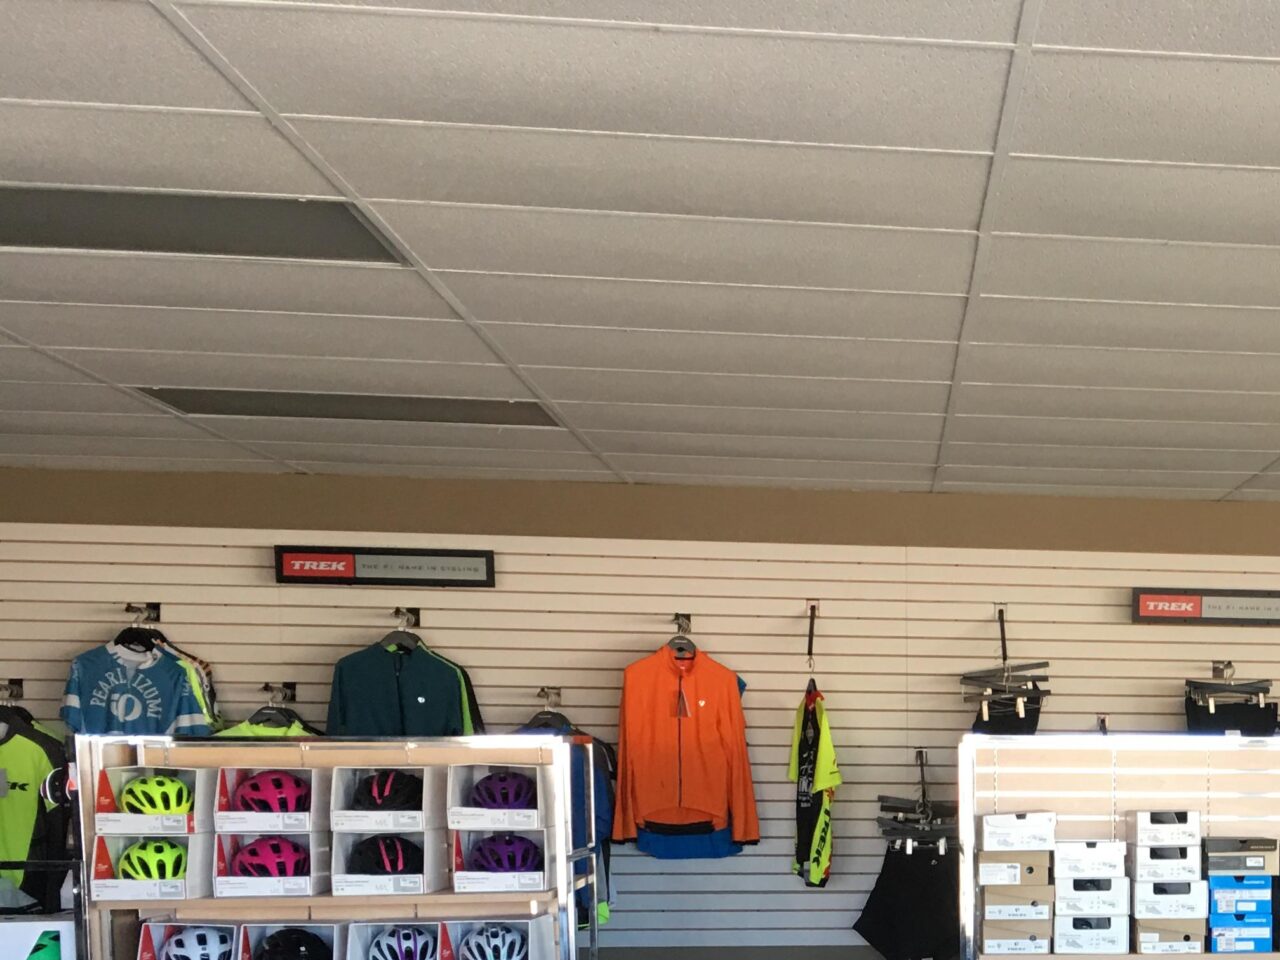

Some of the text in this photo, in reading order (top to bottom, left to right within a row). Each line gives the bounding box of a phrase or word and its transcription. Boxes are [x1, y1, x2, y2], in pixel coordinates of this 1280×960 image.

[290, 560, 347, 571] TREK
[1146, 601, 1195, 611] TREK
[89, 667, 127, 708] PEARL
[131, 673, 164, 720] IZUMI
[813, 808, 831, 869] TREK
